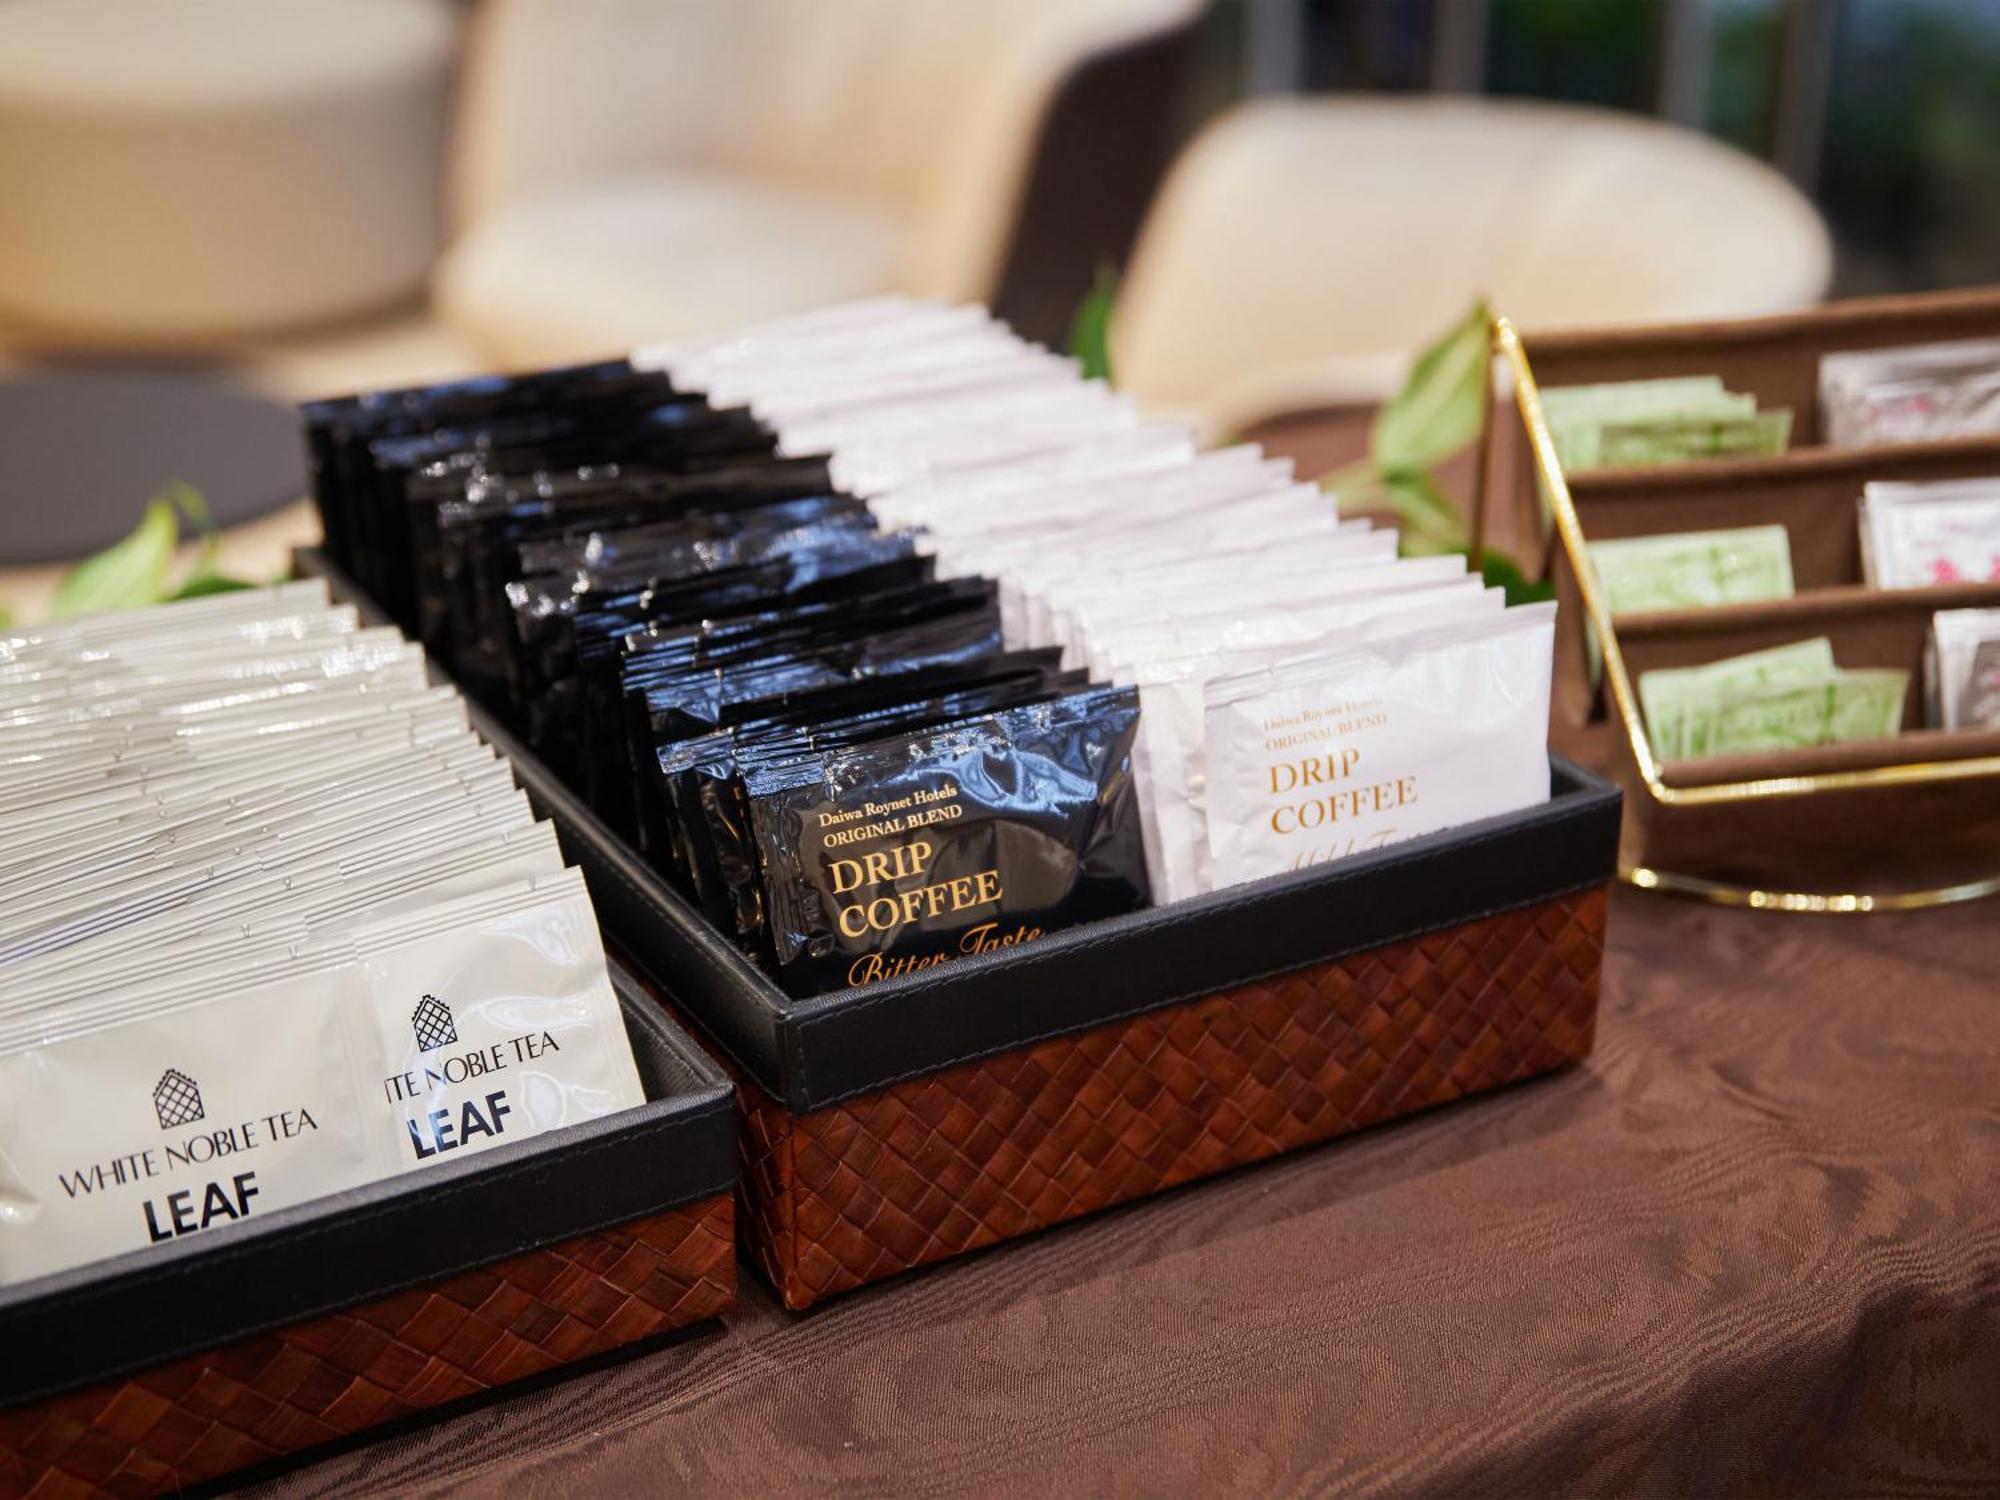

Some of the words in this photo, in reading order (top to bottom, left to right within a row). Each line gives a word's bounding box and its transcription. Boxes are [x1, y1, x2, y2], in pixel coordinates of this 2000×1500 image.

[1265, 727, 1335, 751] ORIGINAL
[1337, 711, 1389, 735] BLEND
[1269, 748, 1360, 794] DRIP
[819, 807, 863, 828] Daiwa
[865, 796, 912, 819] Roynet
[913, 784, 958, 804] Hotels
[823, 818, 905, 849] ORIGINAL
[908, 804, 963, 830] BLEND
[1270, 776, 1419, 835] COFFEE
[828, 841, 933, 894] DRIP
[839, 869, 1004, 938] COFFEE
[384, 1071, 421, 1104] ITE
[425, 1043, 508, 1091] NOBLE
[508, 1031, 560, 1063] TEA
[58, 1150, 160, 1199] WHITE
[165, 1121, 260, 1171] NOBLE
[261, 1108, 318, 1142] TEA
[407, 1090, 511, 1160] LEAF
[143, 1171, 259, 1243] LEAF
